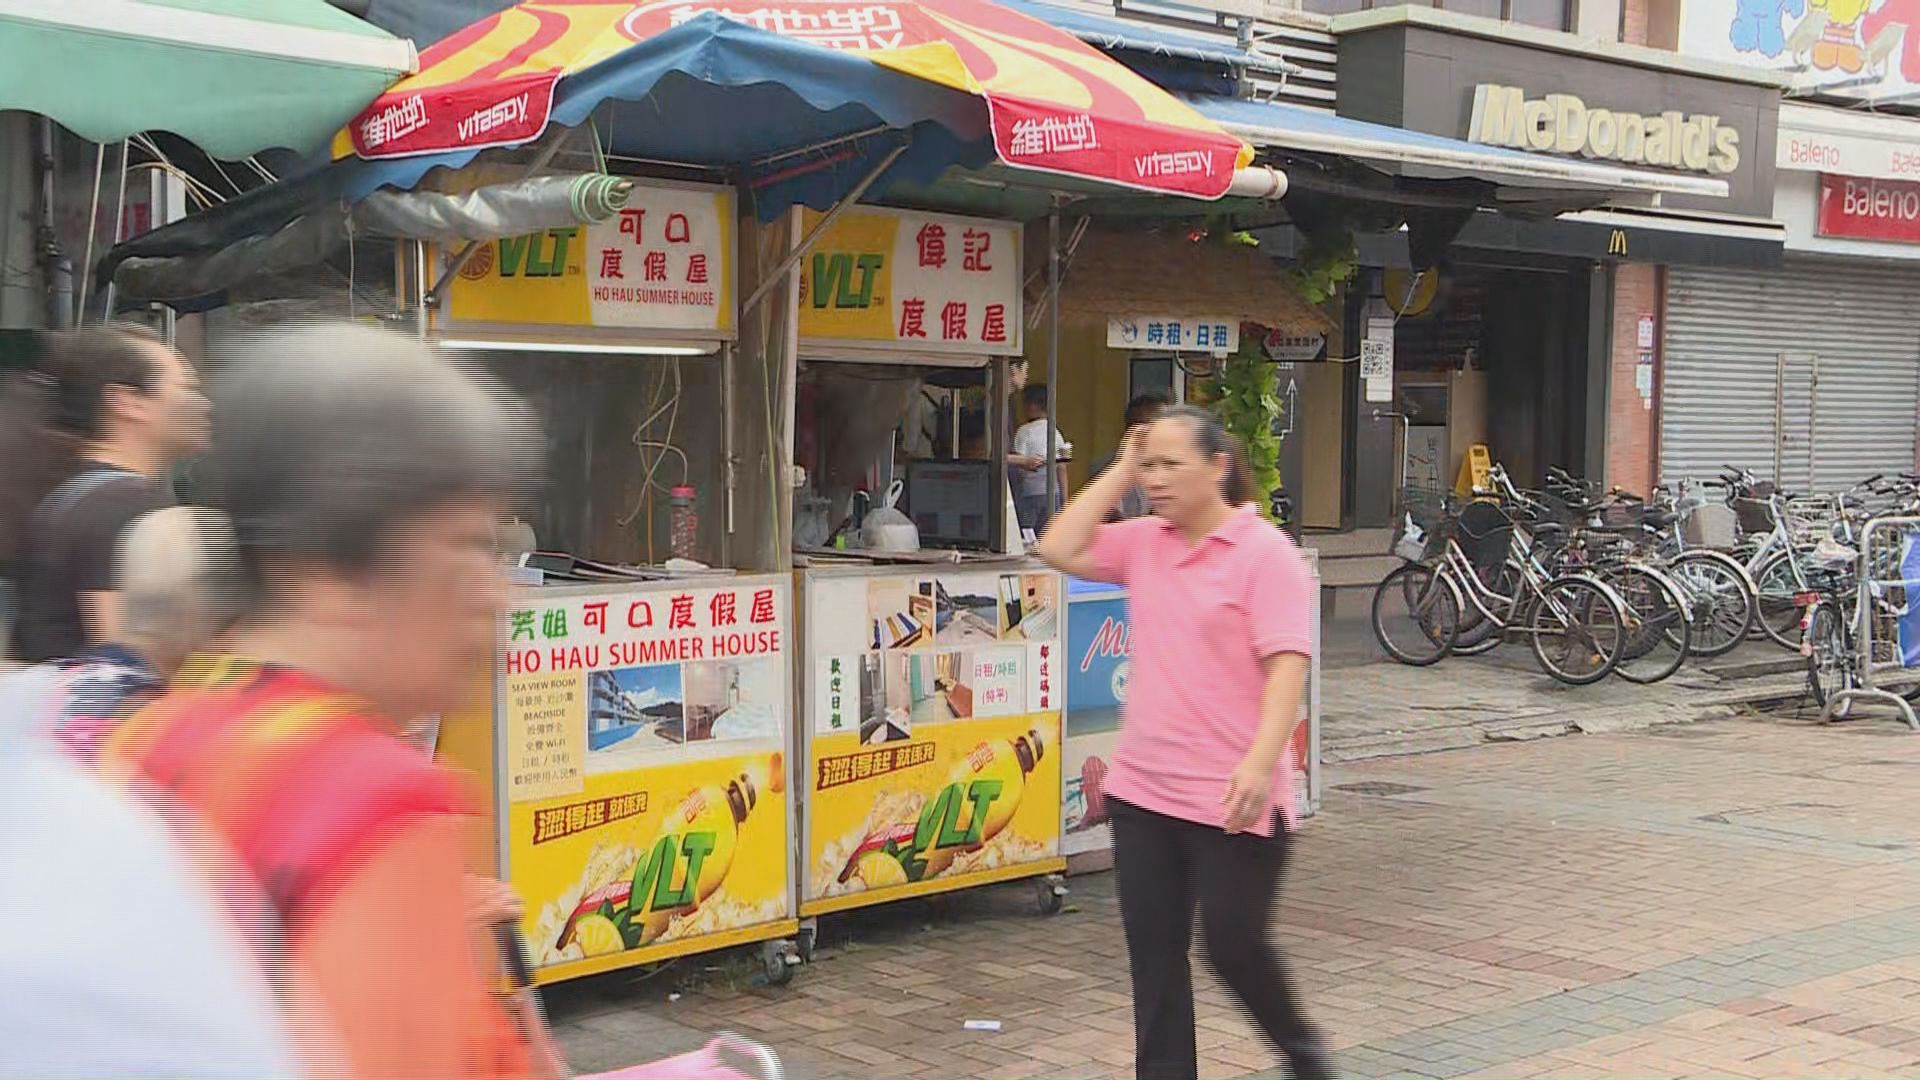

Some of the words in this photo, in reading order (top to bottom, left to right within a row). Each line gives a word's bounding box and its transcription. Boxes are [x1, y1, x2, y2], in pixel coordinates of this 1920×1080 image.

[360, 94, 429, 150] 維他奶
[457, 92, 529, 141] vitasoy
[1010, 114, 1098, 156] 維他奶
[1469, 84, 1740, 173] McDonald's
[1134, 150, 1214, 177] vitasoy
[1790, 139, 1840, 166] Baleno
[1843, 179, 1919, 220] Baleno
[618, 207, 691, 245] 可口
[916, 222, 992, 272] 偉記
[600, 247, 708, 284] 度假屋
[812, 252, 884, 309] VLT
[594, 287, 610, 300] HO
[612, 287, 634, 302] HAU
[636, 288, 679, 305] SUMMER
[681, 289, 714, 306] HOUSE
[899, 297, 1006, 342] 度假屋
[583, 589, 776, 635] 可口度假屋
[505, 649, 541, 675] HO
[551, 644, 600, 671] HAU
[609, 636, 704, 666] SUMMER
[712, 631, 781, 657] HOUSE
[912, 779, 1004, 853] VLT
[627, 831, 717, 916] VLT
